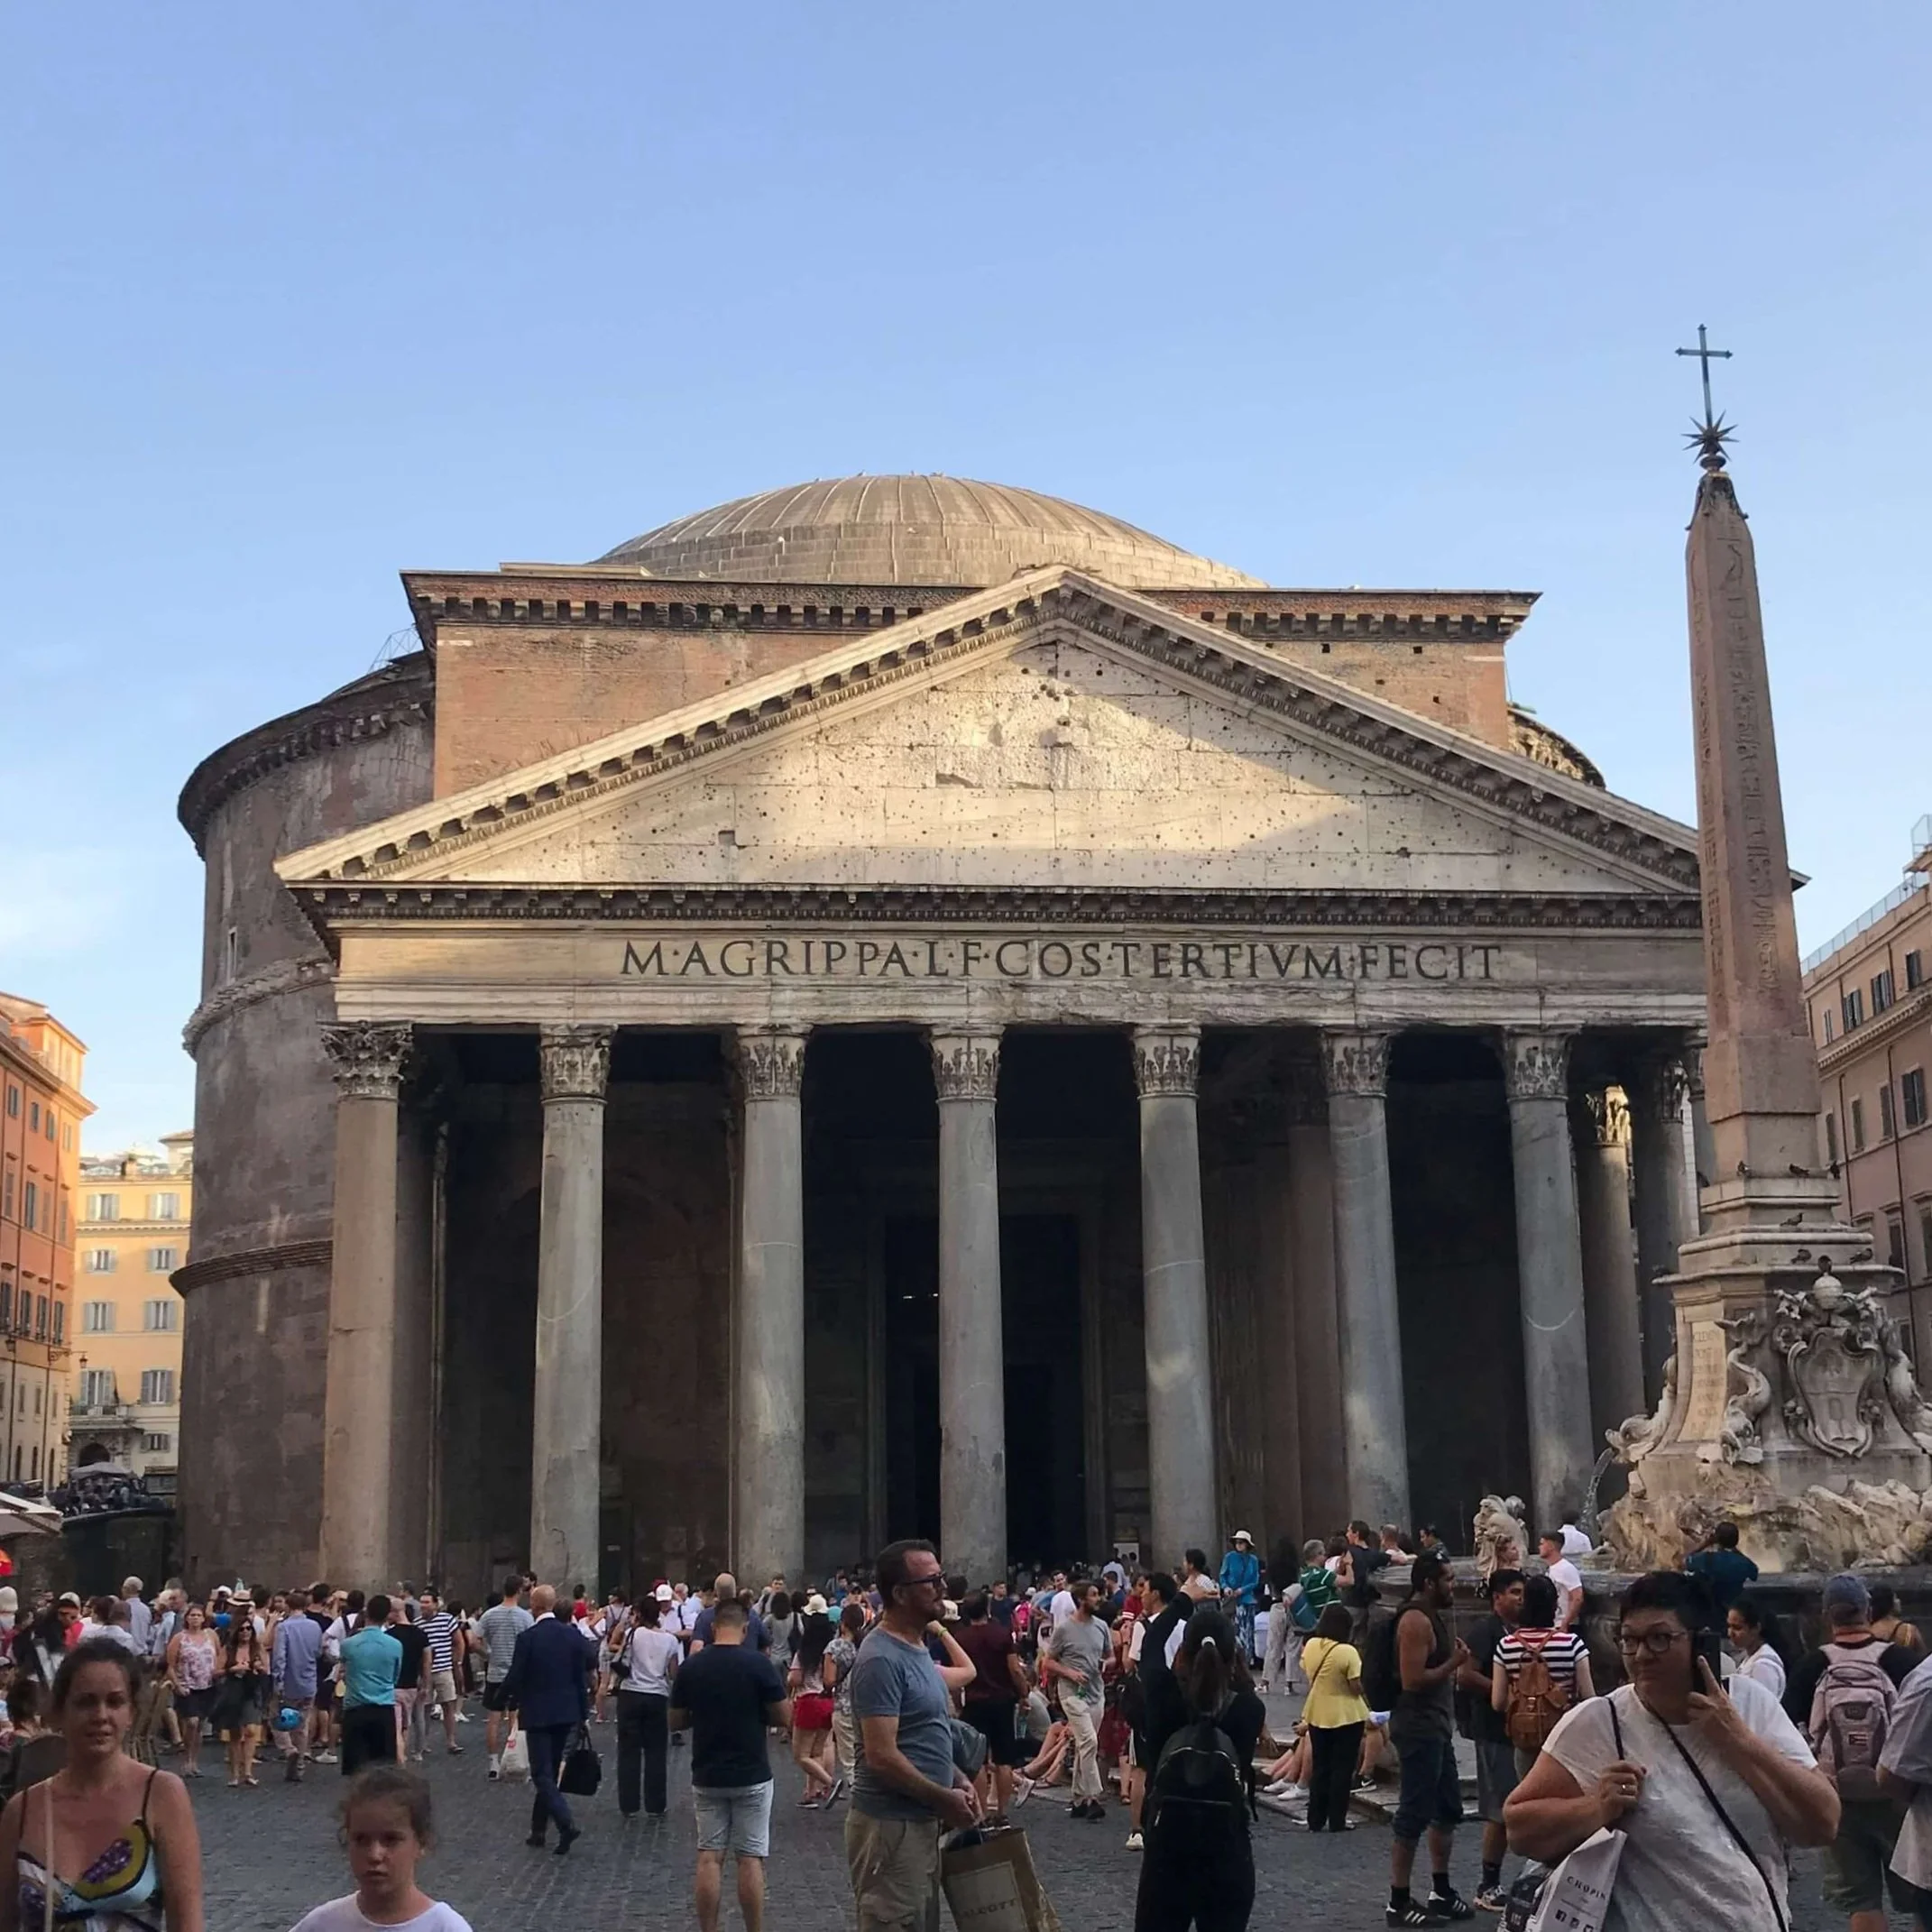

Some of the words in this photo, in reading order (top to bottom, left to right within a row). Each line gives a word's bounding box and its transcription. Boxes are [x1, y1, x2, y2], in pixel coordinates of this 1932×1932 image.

[620, 941, 668, 977] M
[679, 940, 915, 978] AGRIPPA
[925, 941, 950, 978] L
[961, 941, 983, 978] F
[995, 941, 1102, 978] COS
[1111, 943, 1347, 980] TERTIVM
[1358, 944, 1502, 980] FECIT
[1567, 1875, 1605, 1900] CHOPIN
